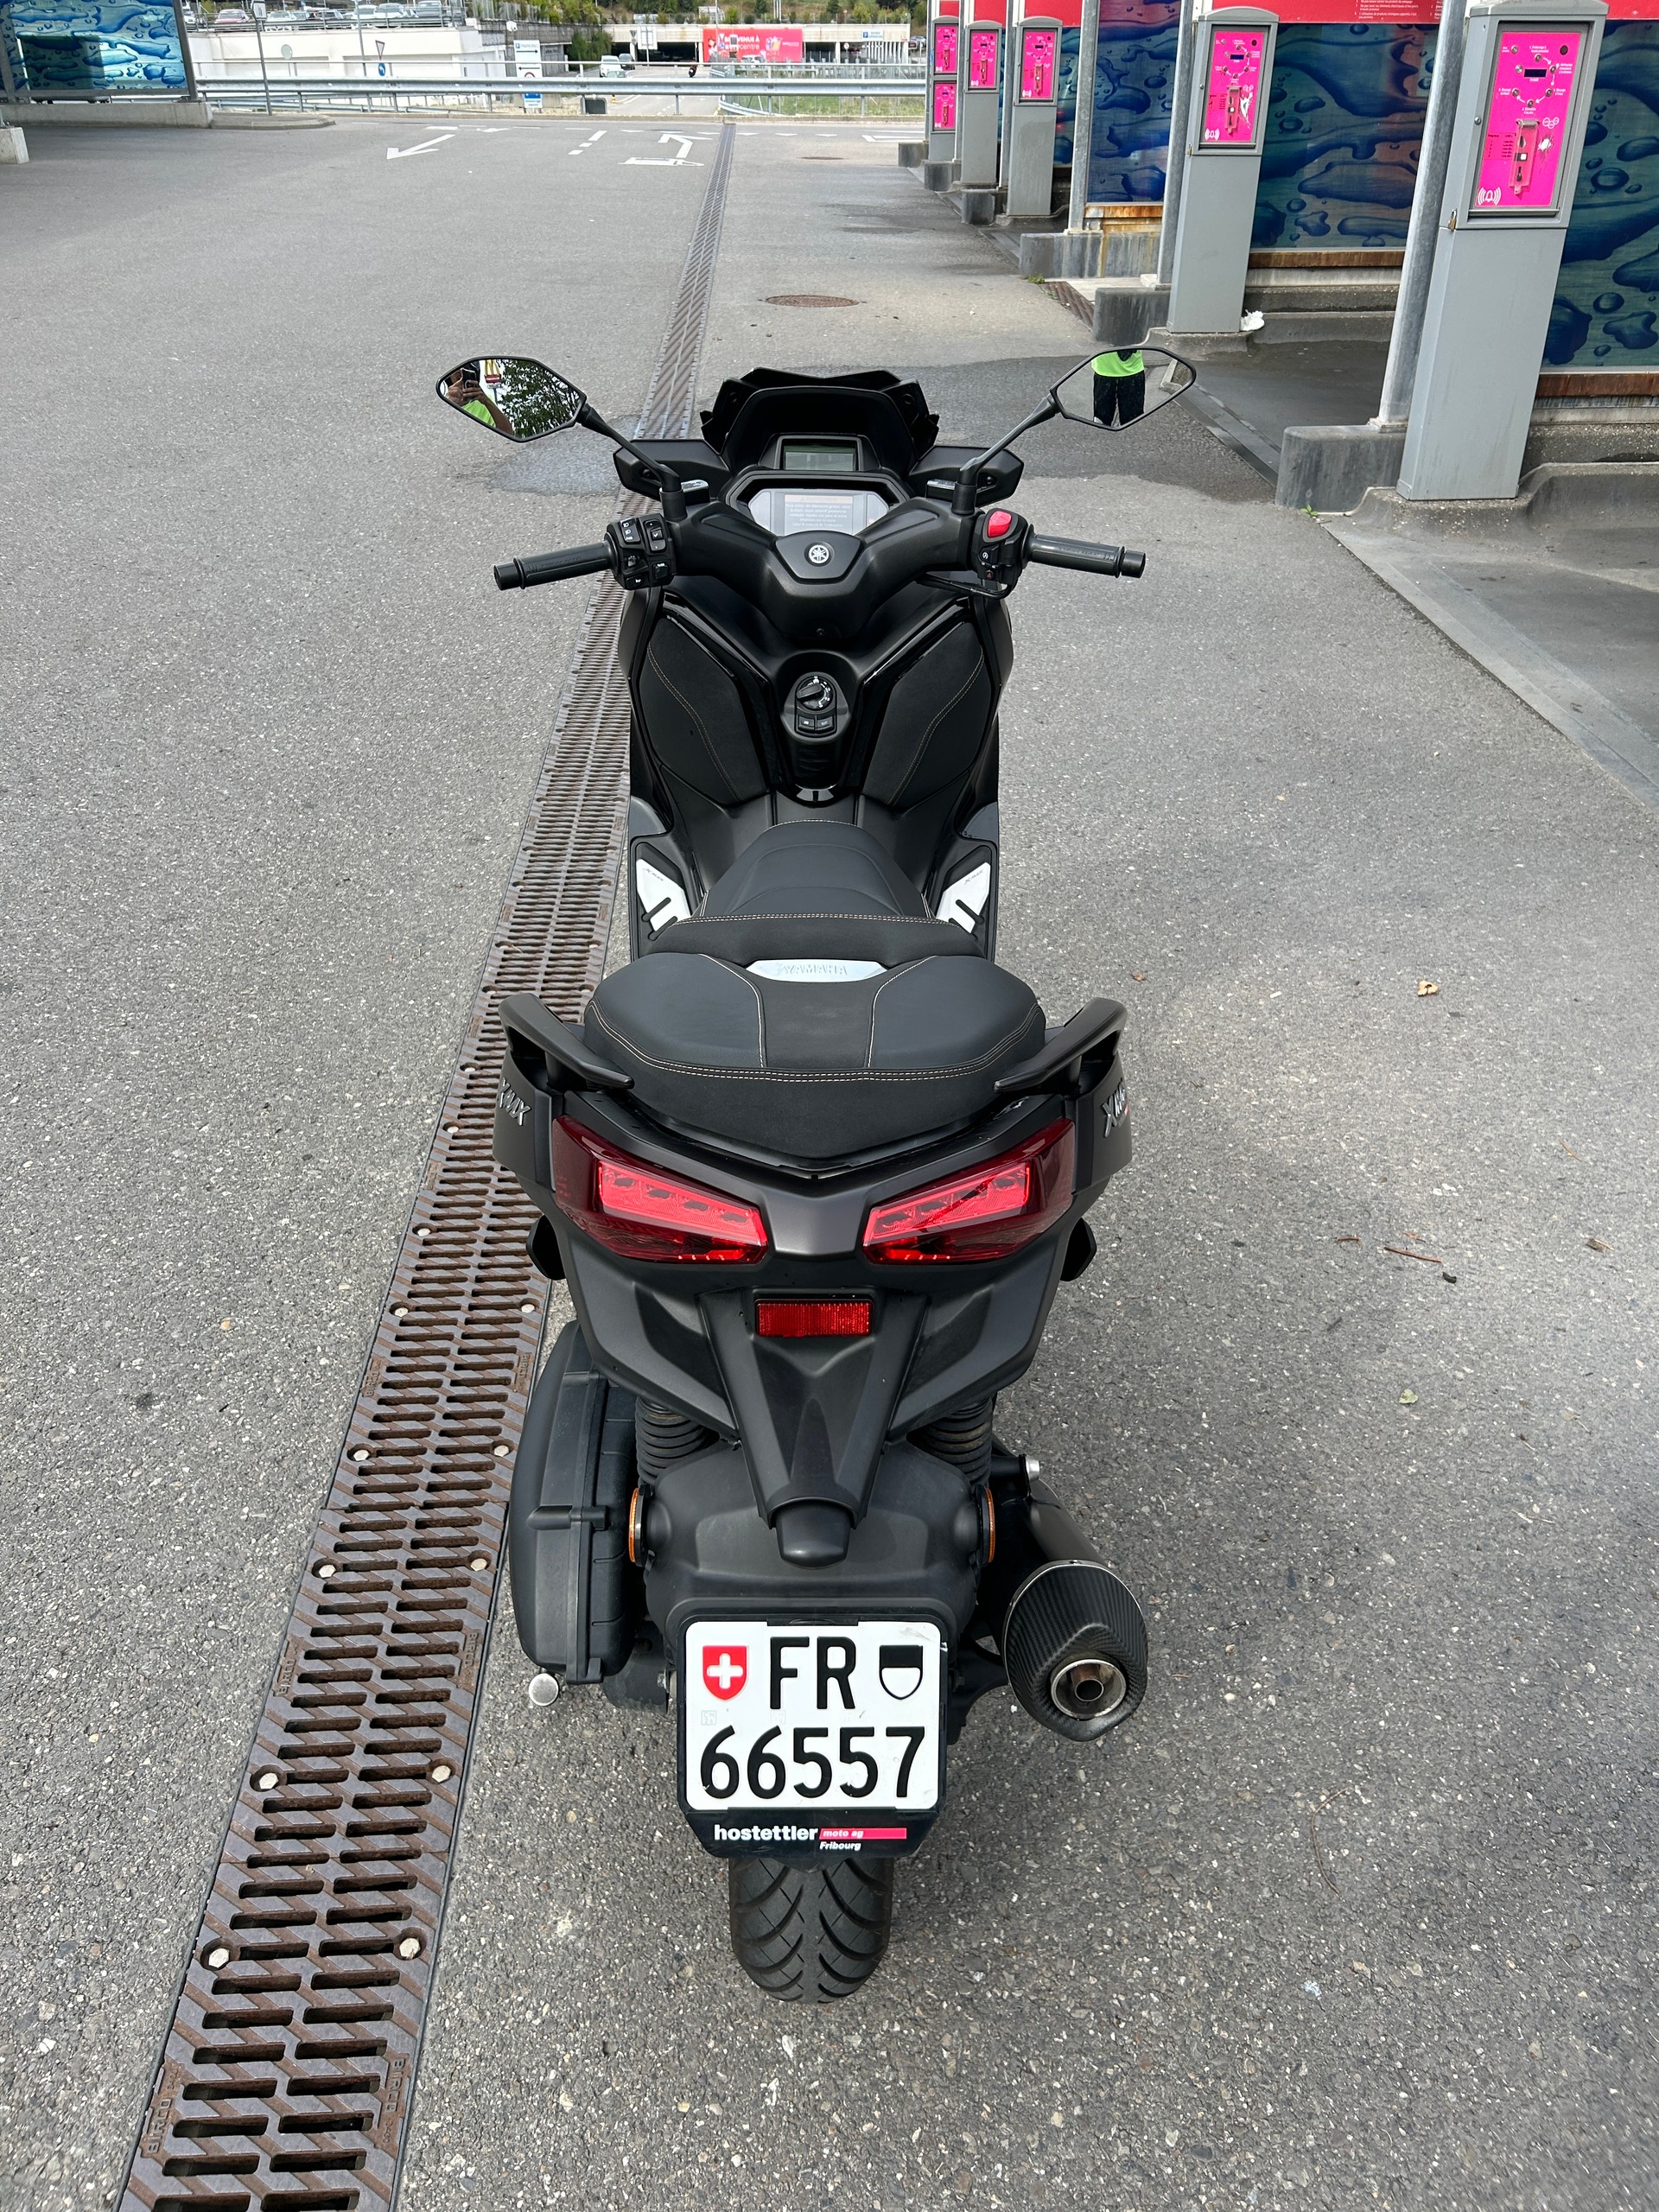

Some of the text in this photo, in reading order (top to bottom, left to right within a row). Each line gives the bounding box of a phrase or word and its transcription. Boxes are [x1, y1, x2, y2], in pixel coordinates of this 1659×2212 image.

[785, 964, 848, 976] YAMAHA
[770, 1636, 856, 1710] FR
[700, 1725, 925, 1799] 66557
[714, 1824, 864, 1840] hostettler moto ag
[819, 1841, 861, 1852] Fribourg
[385, 2058, 404, 2113] BIRCO
[146, 2098, 172, 2154] BIRCO
